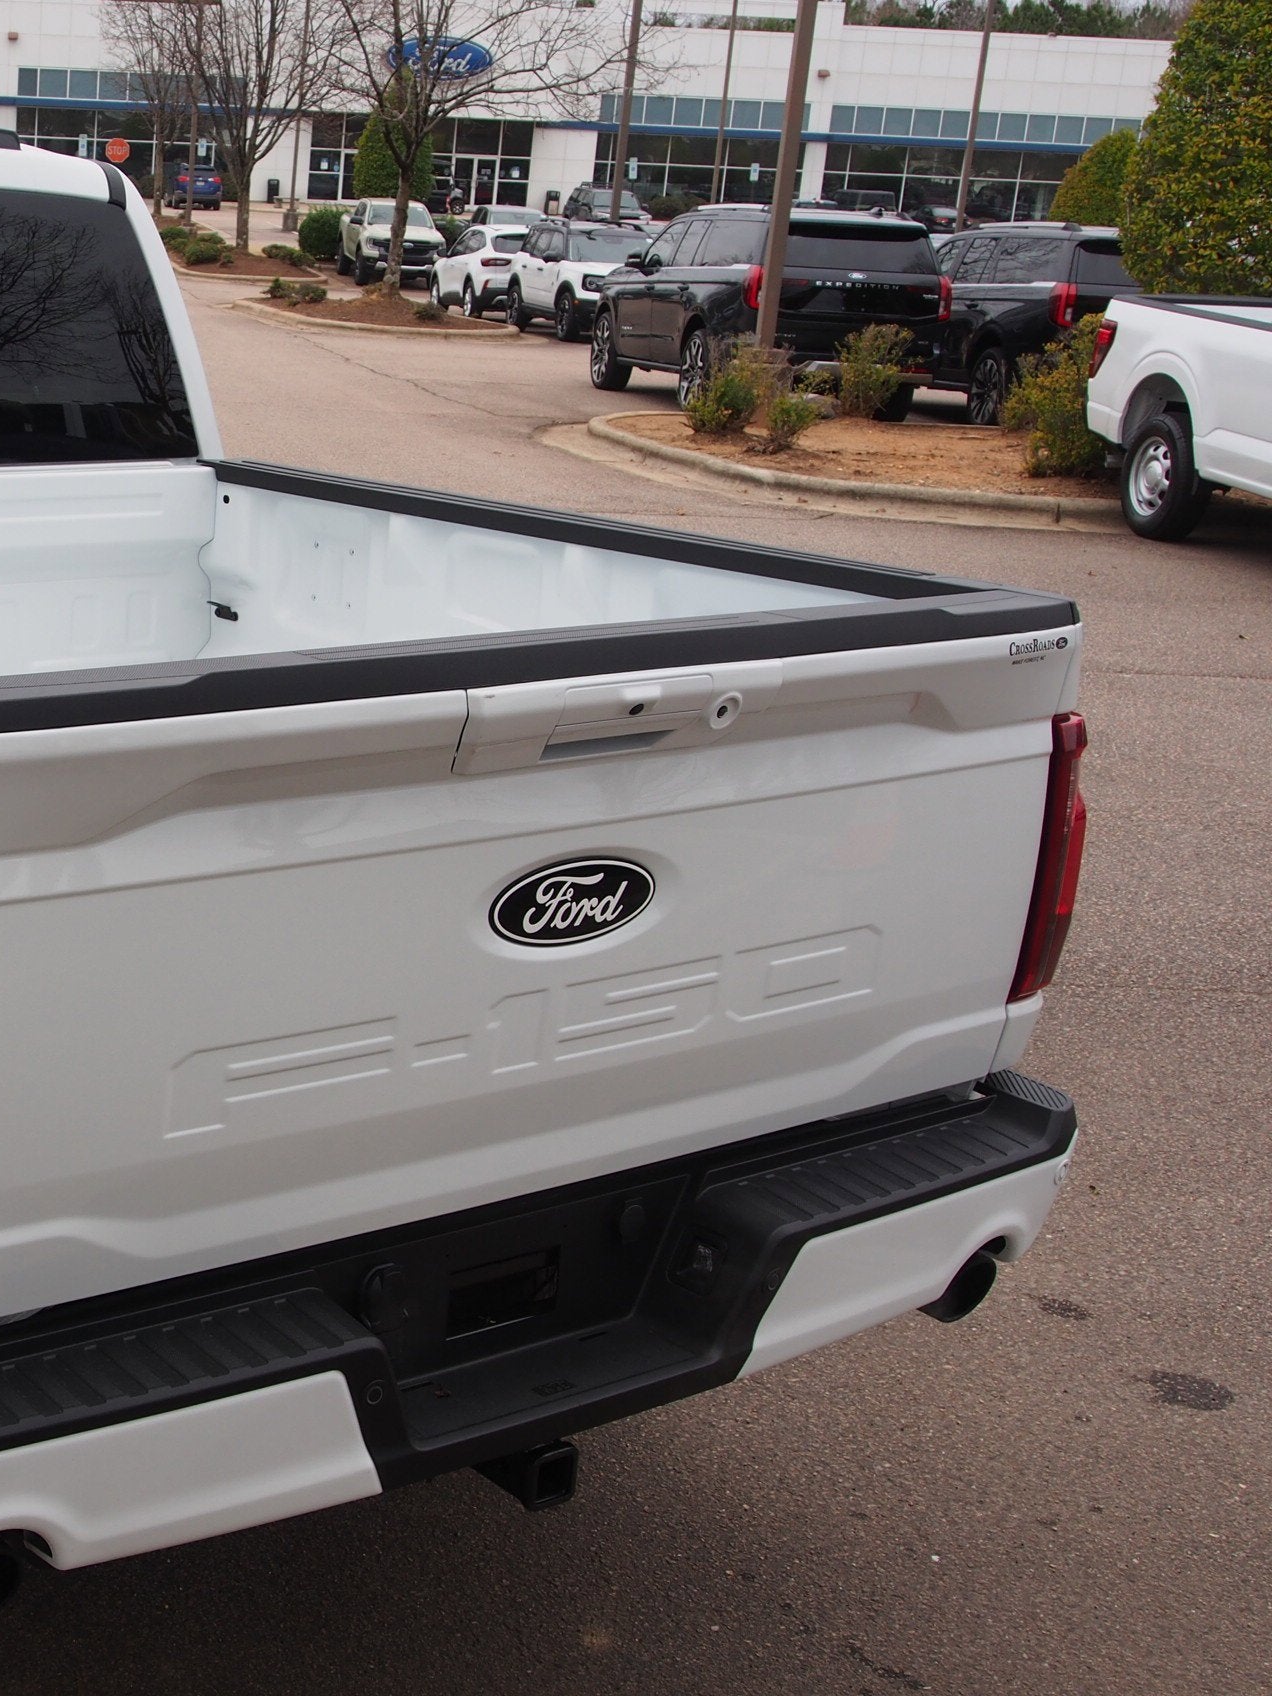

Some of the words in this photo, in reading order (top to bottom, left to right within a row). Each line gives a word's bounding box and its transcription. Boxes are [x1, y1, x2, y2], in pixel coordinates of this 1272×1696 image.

[108, 145, 129, 156] STOP
[815, 280, 900, 291] EXPEDITION
[523, 872, 628, 934] Ford
[164, 924, 883, 1140] F-150
